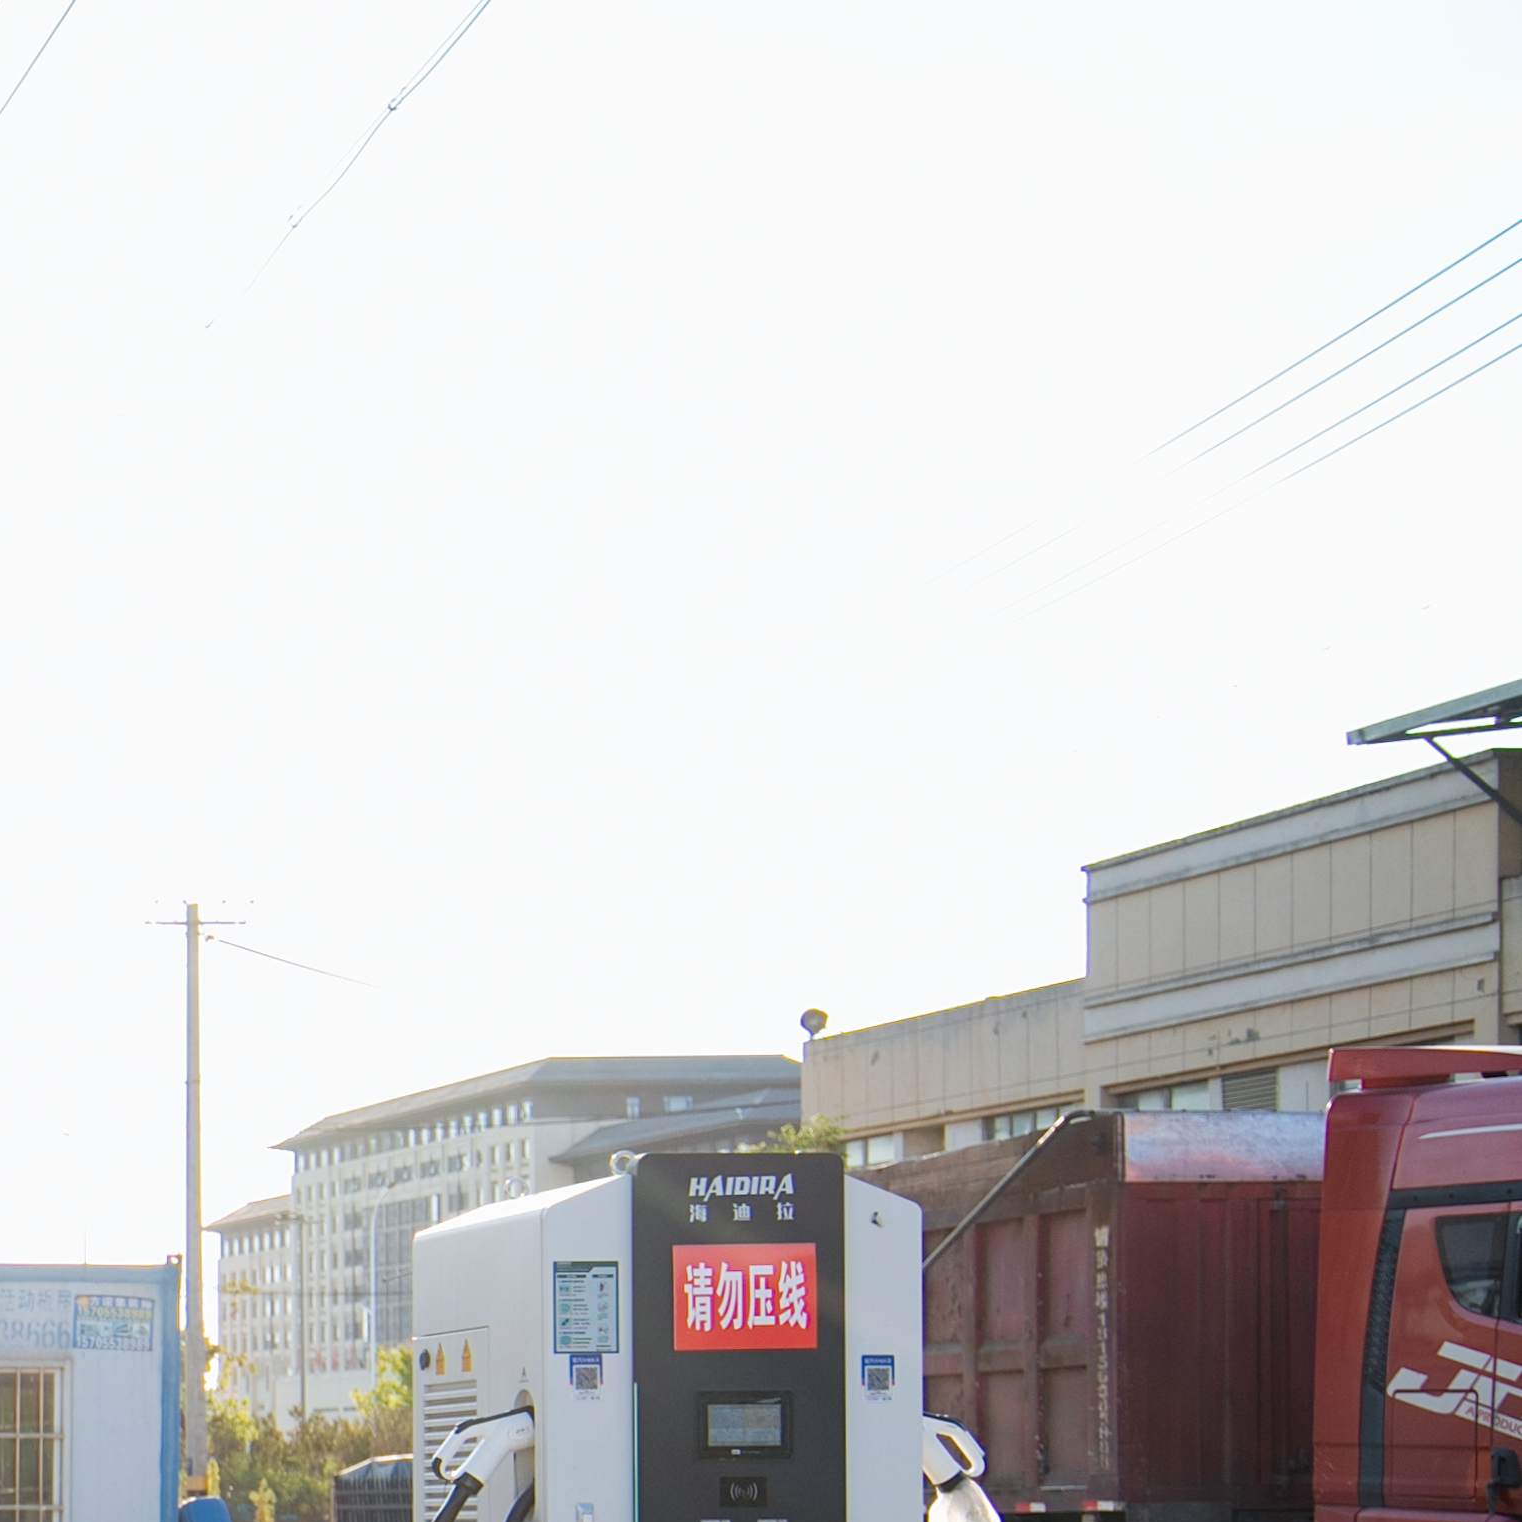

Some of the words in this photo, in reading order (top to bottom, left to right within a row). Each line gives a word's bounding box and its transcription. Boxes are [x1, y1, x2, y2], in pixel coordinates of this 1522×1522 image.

[688, 1174, 795, 1202] HAIDIRA
[689, 1202, 794, 1223] 海迪拉
[684, 1261, 808, 1332] 请勿压线
